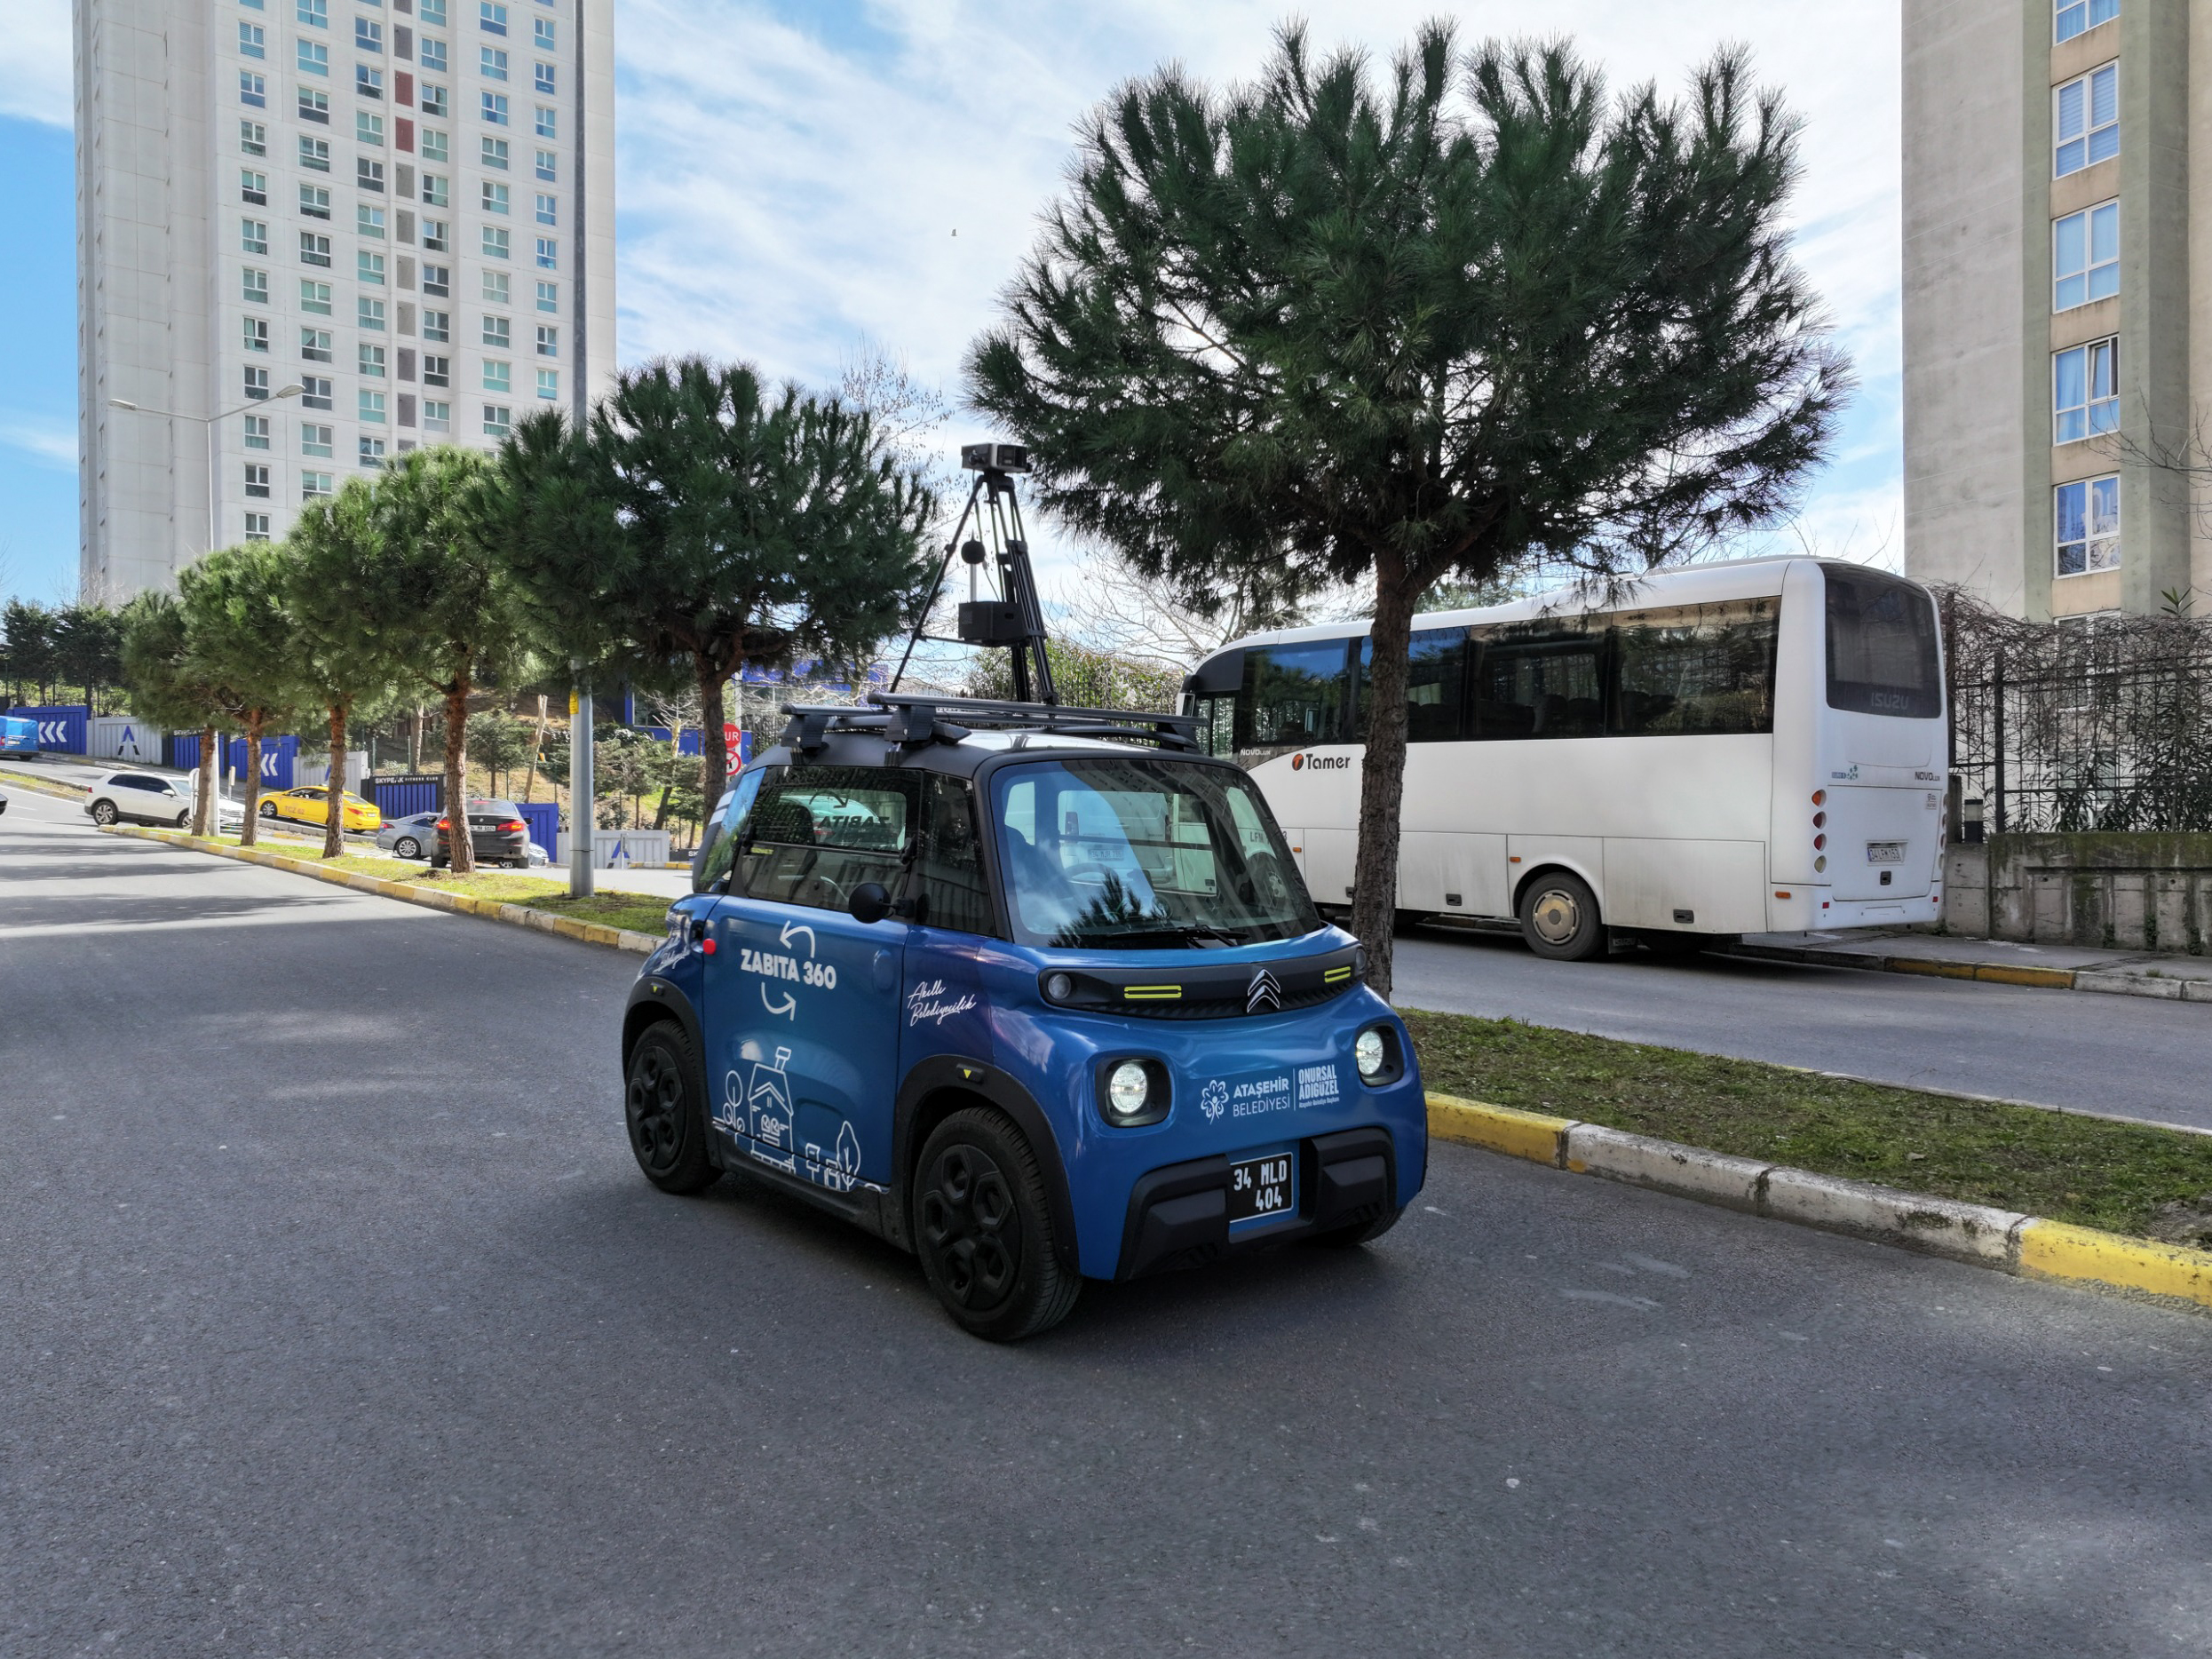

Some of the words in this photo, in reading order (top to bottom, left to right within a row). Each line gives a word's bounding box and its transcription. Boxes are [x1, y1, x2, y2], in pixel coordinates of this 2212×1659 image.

[1871, 692, 1909, 710] ISUZU
[724, 731, 740, 742] UR
[1306, 754, 1351, 770] Tamer
[741, 949, 800, 982] ZABITA
[803, 961, 836, 990] 360
[909, 994, 977, 1027] Belediyecilik
[1298, 1064, 1337, 1085] ONURSAL
[1233, 1076, 1289, 1099] ATAŞEHİR
[1298, 1079, 1339, 1100] ADIGÜZEL
[1233, 1093, 1290, 1117] BELEDİYESİ
[1233, 1167, 1252, 1191] 34
[1261, 1160, 1287, 1186] MLD
[1256, 1186, 1282, 1211] 404
